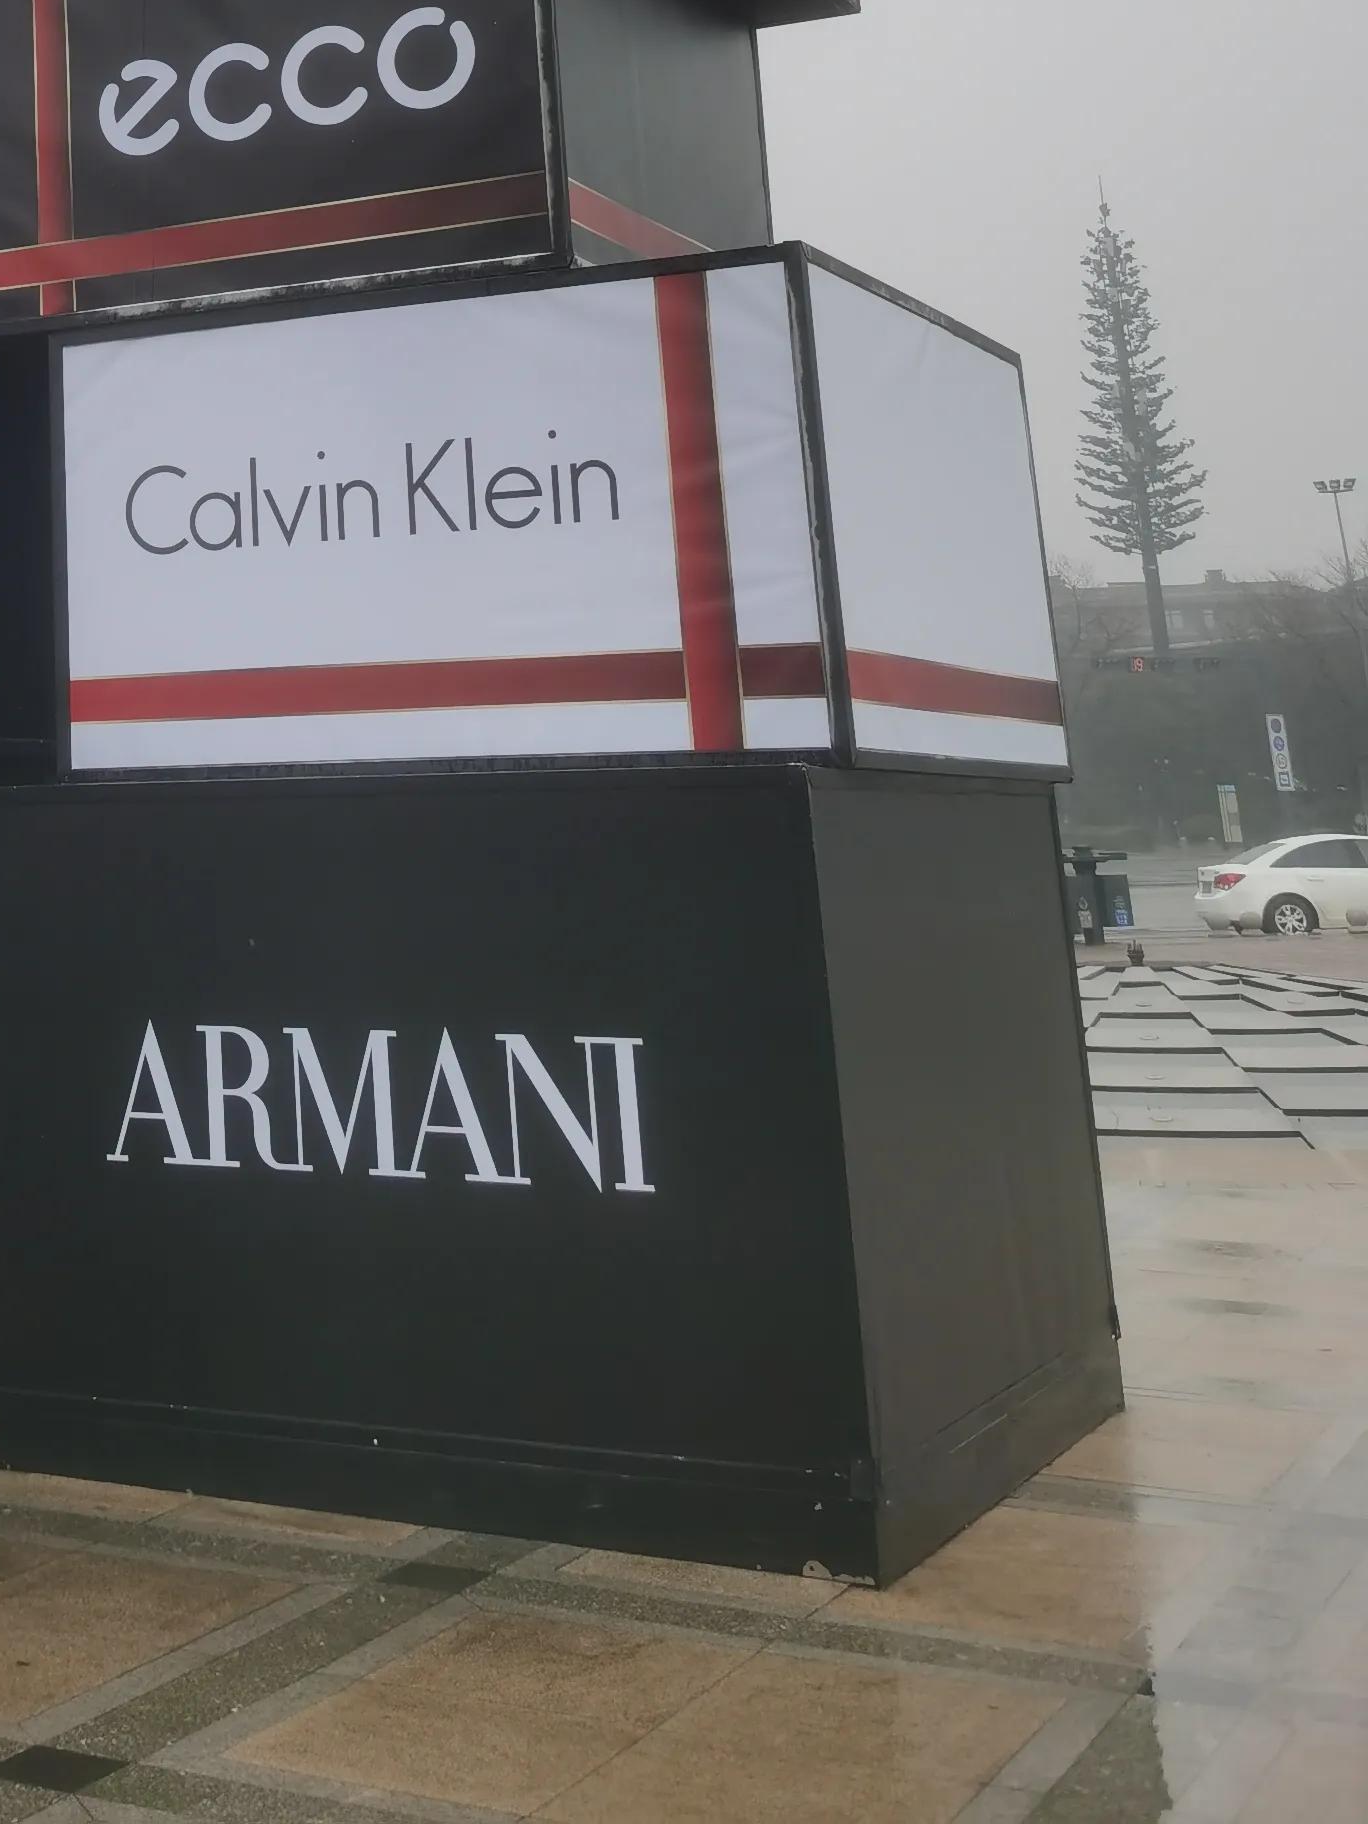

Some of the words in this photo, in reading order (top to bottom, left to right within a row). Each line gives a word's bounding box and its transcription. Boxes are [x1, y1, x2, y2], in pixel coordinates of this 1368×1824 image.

[98, 6, 476, 156] ecco
[125, 450, 381, 555] Calvin
[404, 429, 620, 536] Klein
[106, 1018, 656, 1193] ARMANI
